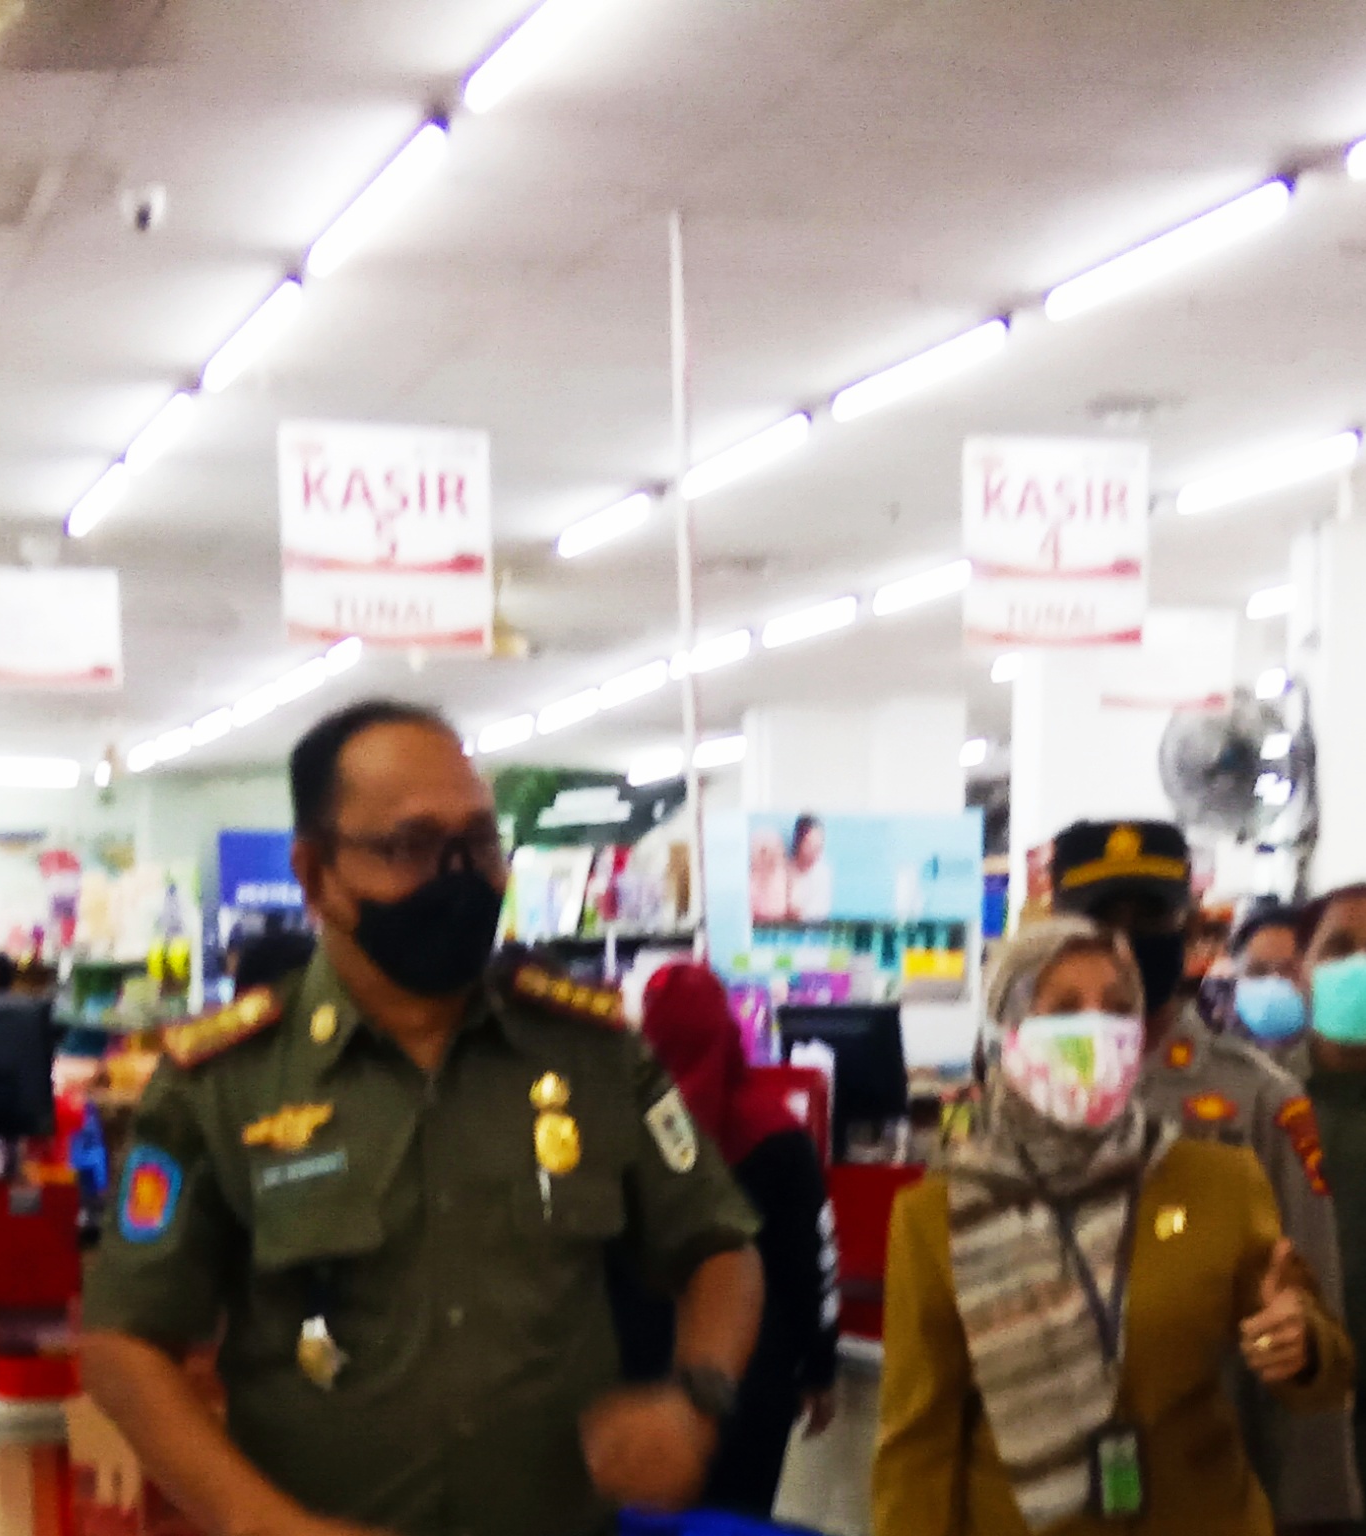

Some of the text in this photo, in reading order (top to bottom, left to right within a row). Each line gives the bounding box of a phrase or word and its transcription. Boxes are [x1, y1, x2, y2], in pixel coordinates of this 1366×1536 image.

[302, 465, 468, 517] KASIR
[983, 472, 1128, 523] KASIR
[331, 597, 436, 629] TUNAI
[1005, 601, 1096, 634] TUNAI
